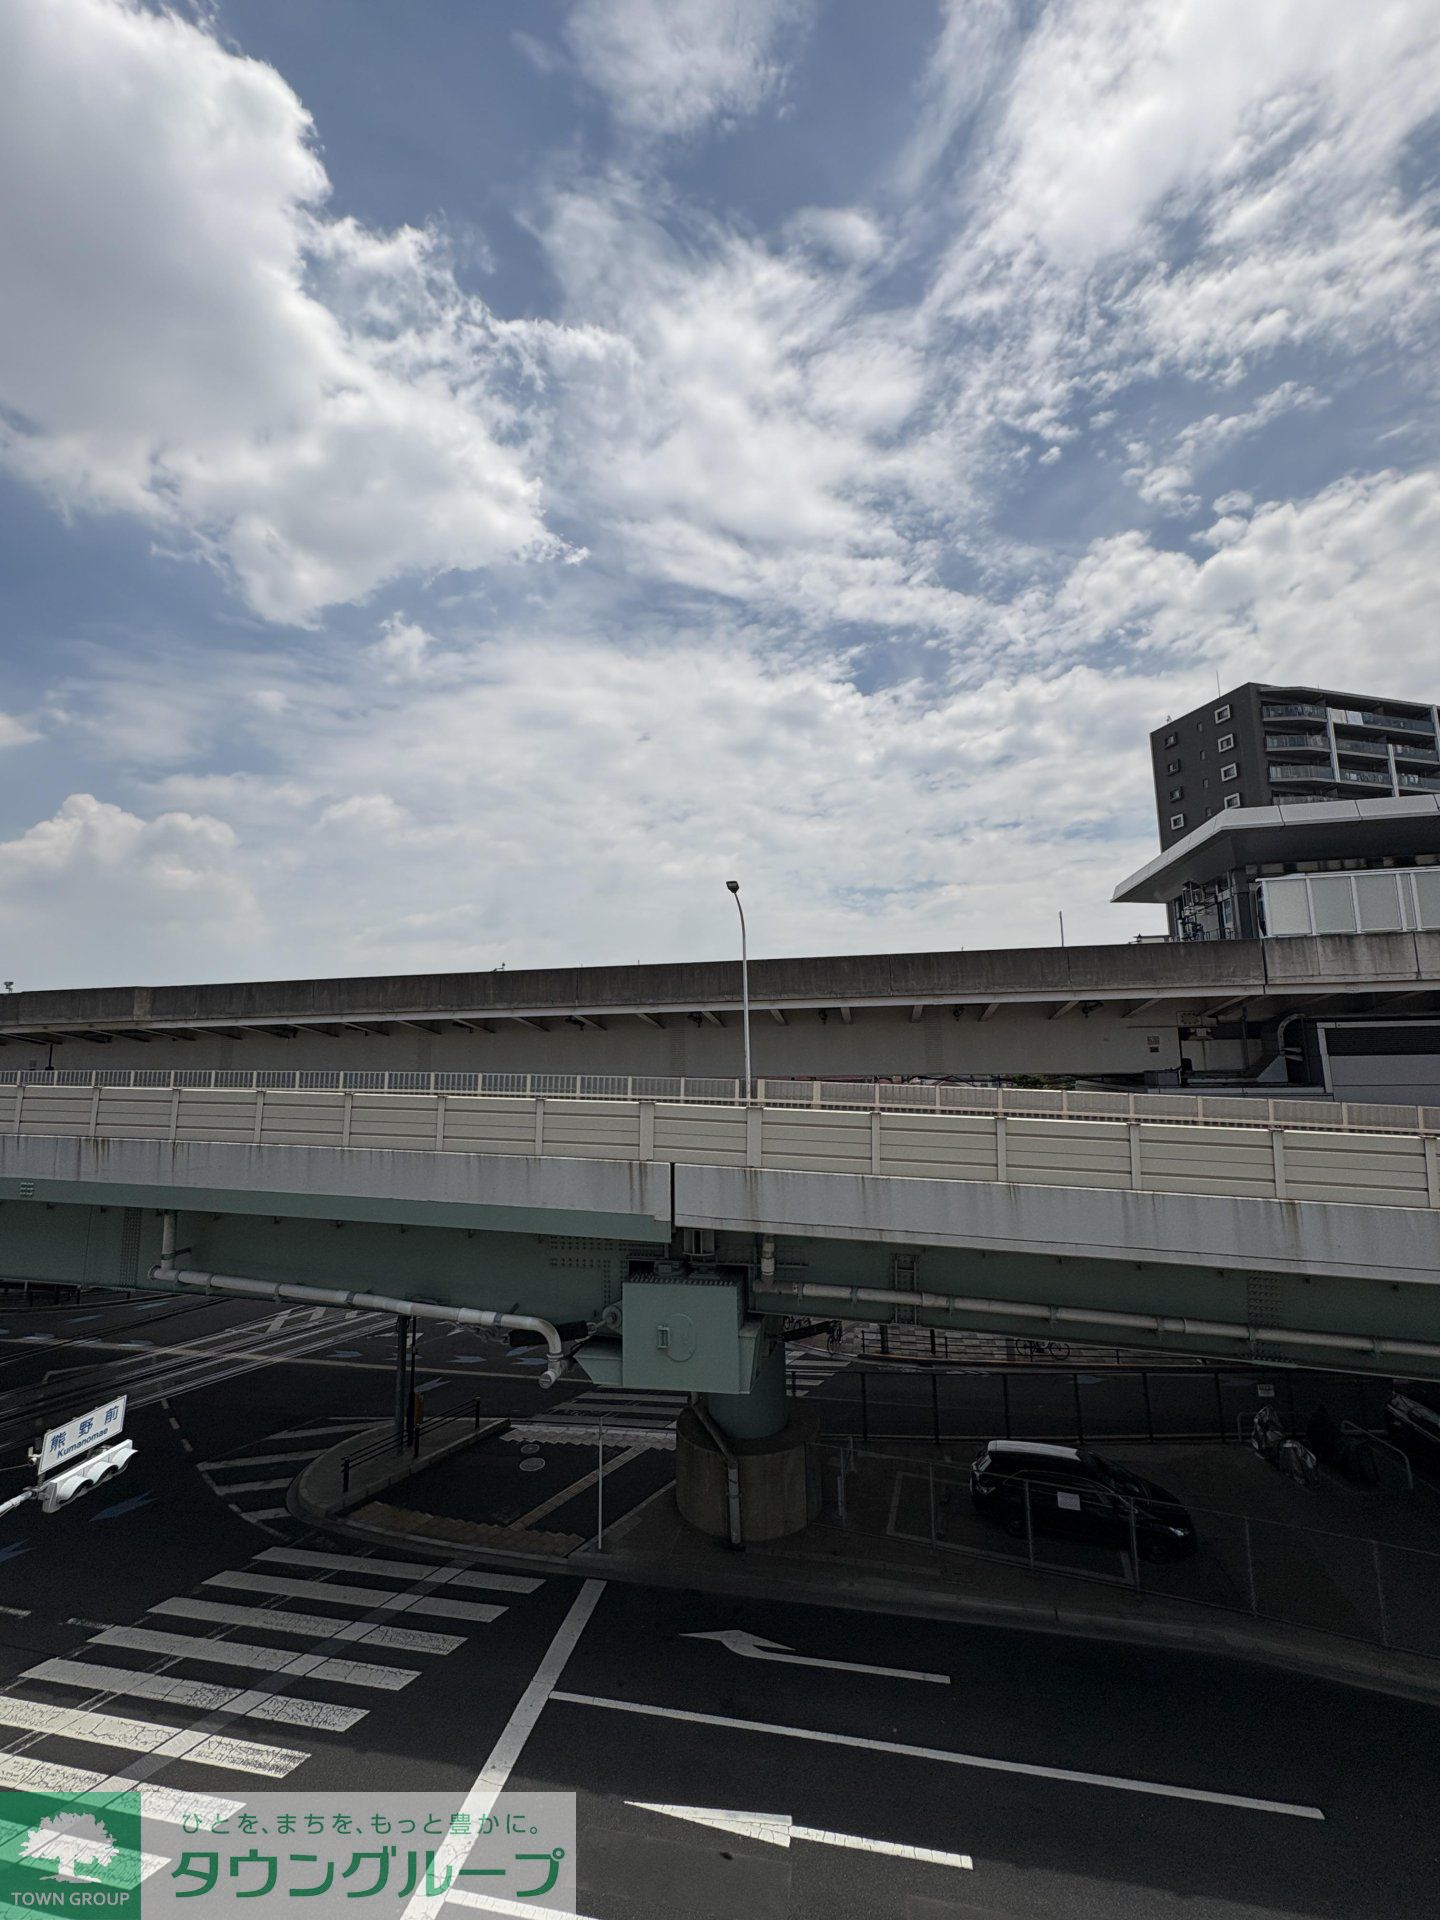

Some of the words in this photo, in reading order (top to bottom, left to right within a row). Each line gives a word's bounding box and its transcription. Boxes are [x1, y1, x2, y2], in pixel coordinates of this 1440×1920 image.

[49, 1405, 120, 1452] 熊野前
[56, 1427, 109, 1459] Kumanomae
